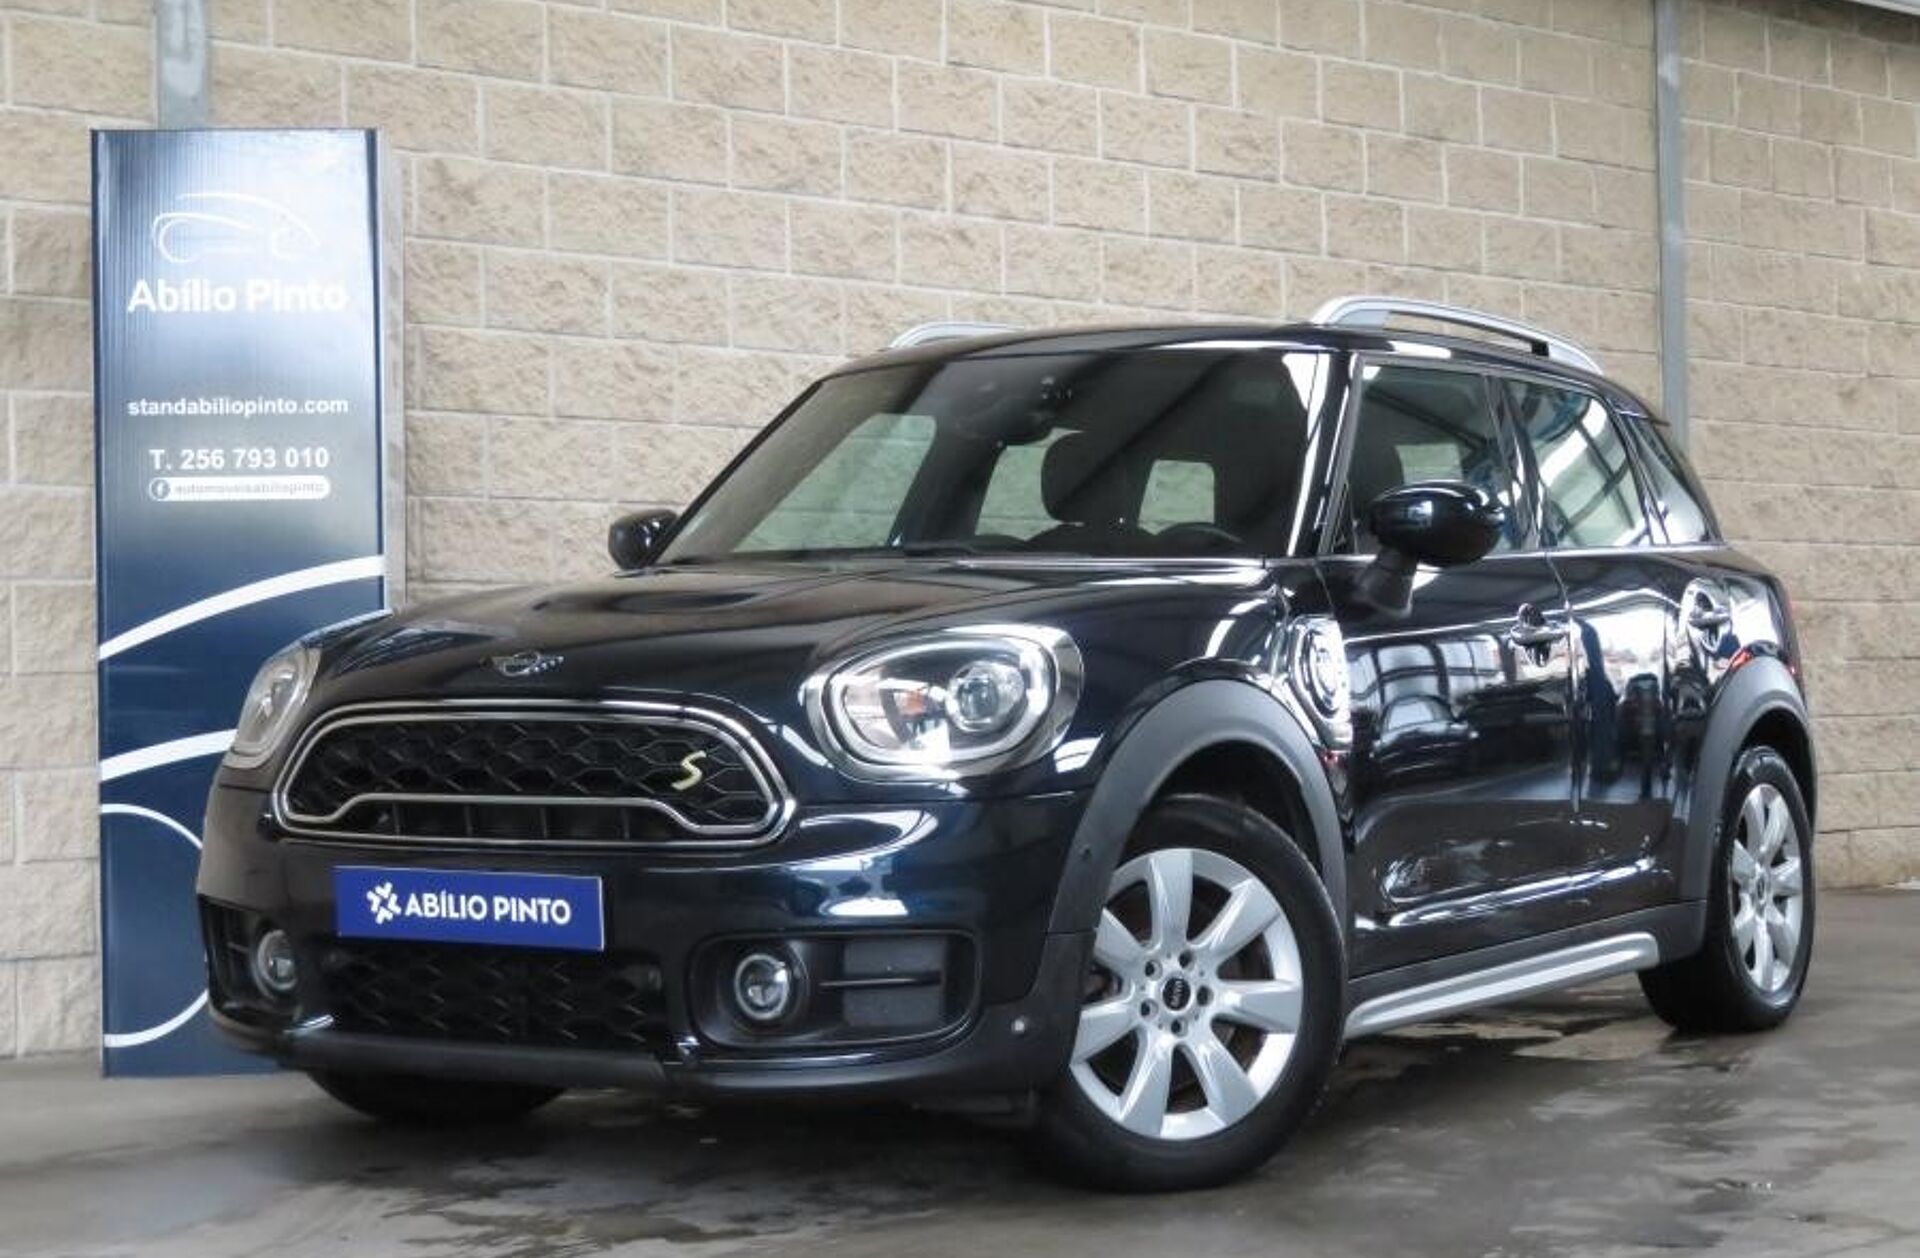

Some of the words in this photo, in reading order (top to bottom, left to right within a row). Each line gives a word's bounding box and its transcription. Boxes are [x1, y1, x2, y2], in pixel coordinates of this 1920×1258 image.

[247, 277, 348, 313] Pinto
[127, 396, 349, 419] standabiliopinto.com
[149, 448, 172, 470] T.
[179, 448, 226, 470] 256
[231, 447, 277, 469] 793
[284, 446, 330, 468] 010
[671, 750, 707, 791] S
[404, 889, 488, 921] ABÍLIO
[493, 895, 572, 926] PINTO
